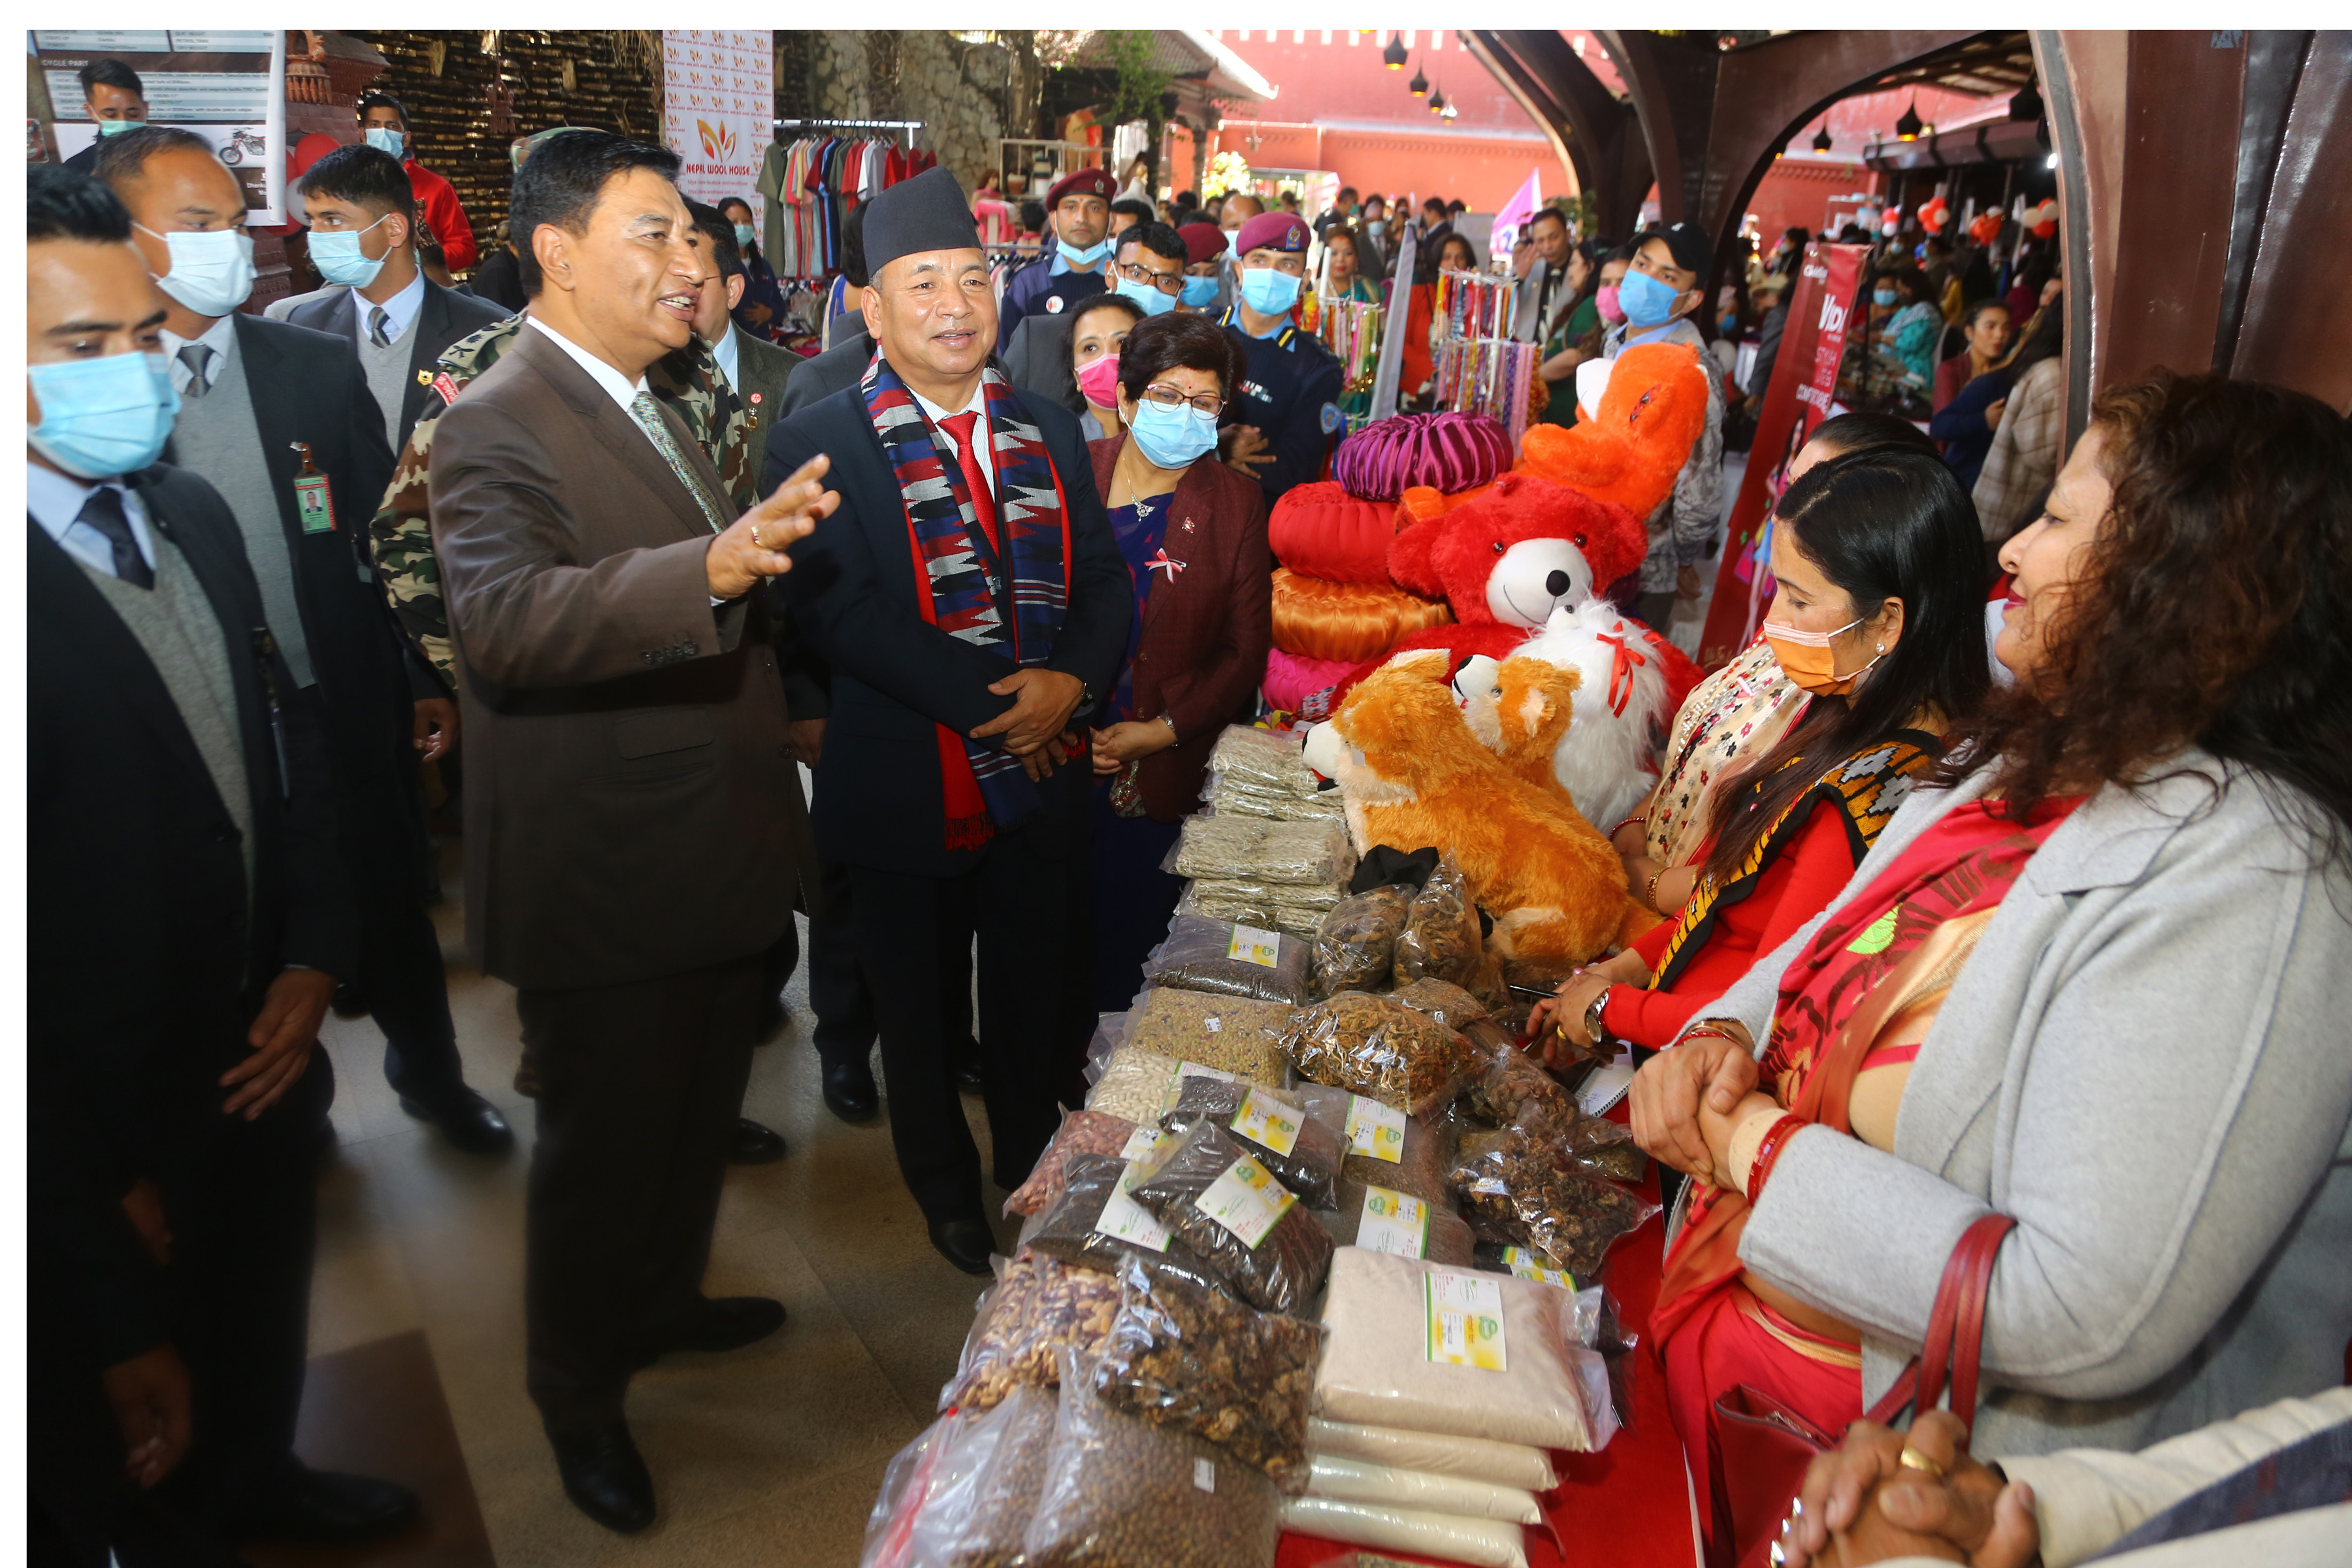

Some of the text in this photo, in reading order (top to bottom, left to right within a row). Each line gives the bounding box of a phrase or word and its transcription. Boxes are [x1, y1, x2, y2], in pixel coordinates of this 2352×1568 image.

[687, 163, 750, 176] NEPAL WOOL HOUSE
